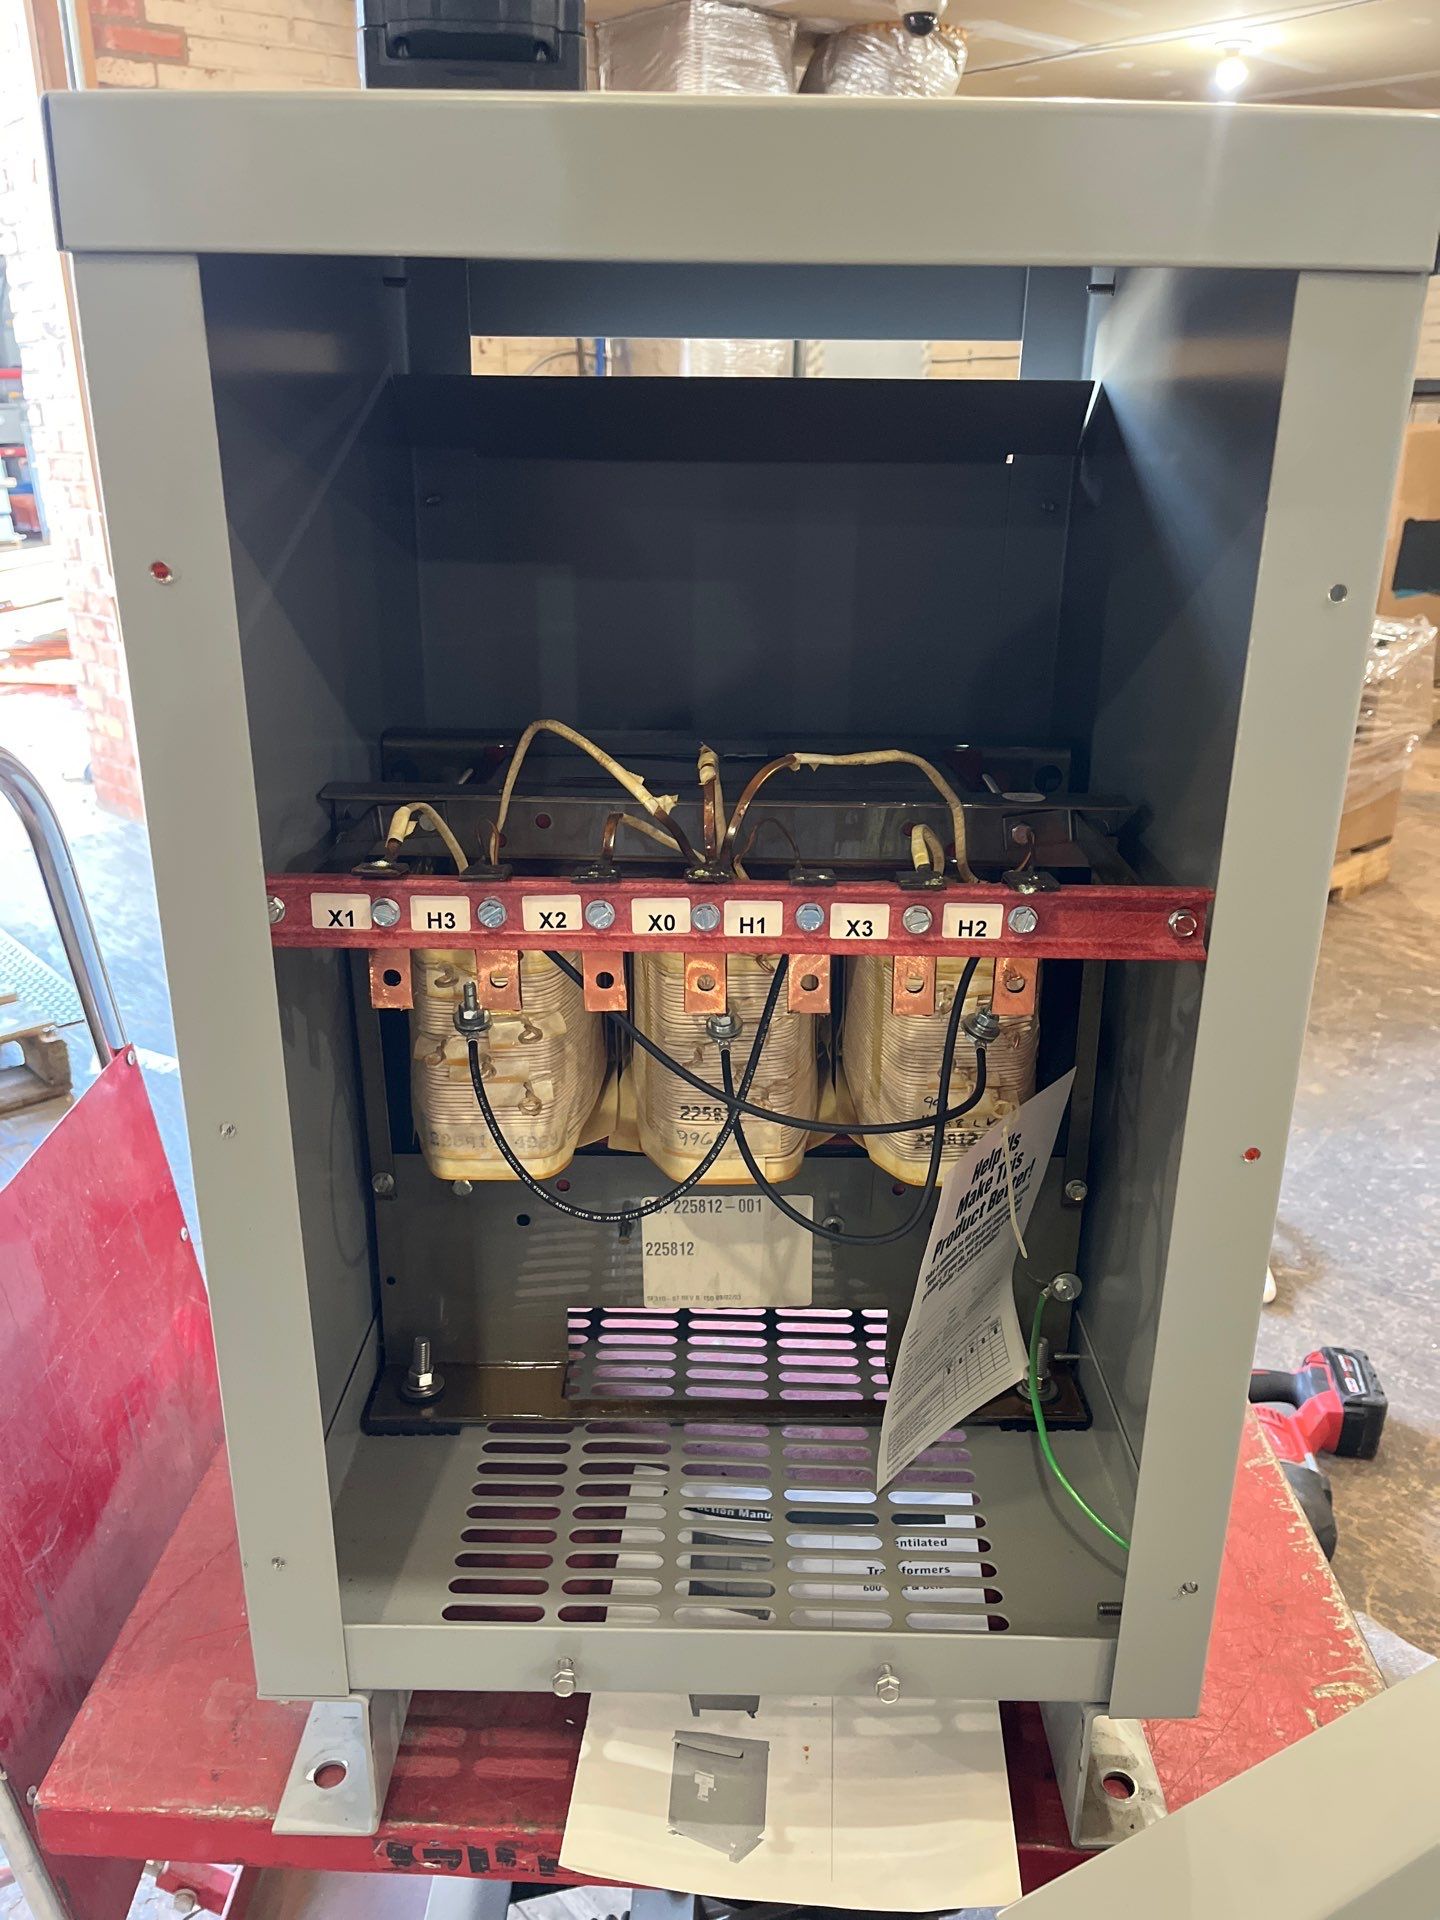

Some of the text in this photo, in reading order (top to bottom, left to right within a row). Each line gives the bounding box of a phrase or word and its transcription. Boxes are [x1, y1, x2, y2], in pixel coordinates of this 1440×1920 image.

[328, 910, 354, 927] X1
[427, 912, 456, 929] H3
[539, 912, 567, 929] X2
[739, 917, 766, 934] H1
[846, 920, 874, 937] X3
[958, 920, 988, 937] H2
[680, 1106, 728, 1123] 2258
[971, 1147, 1002, 1185] Help
[956, 1176, 993, 1219] Make
[932, 1201, 987, 1264] Product
[645, 1241, 694, 1256] 225812
